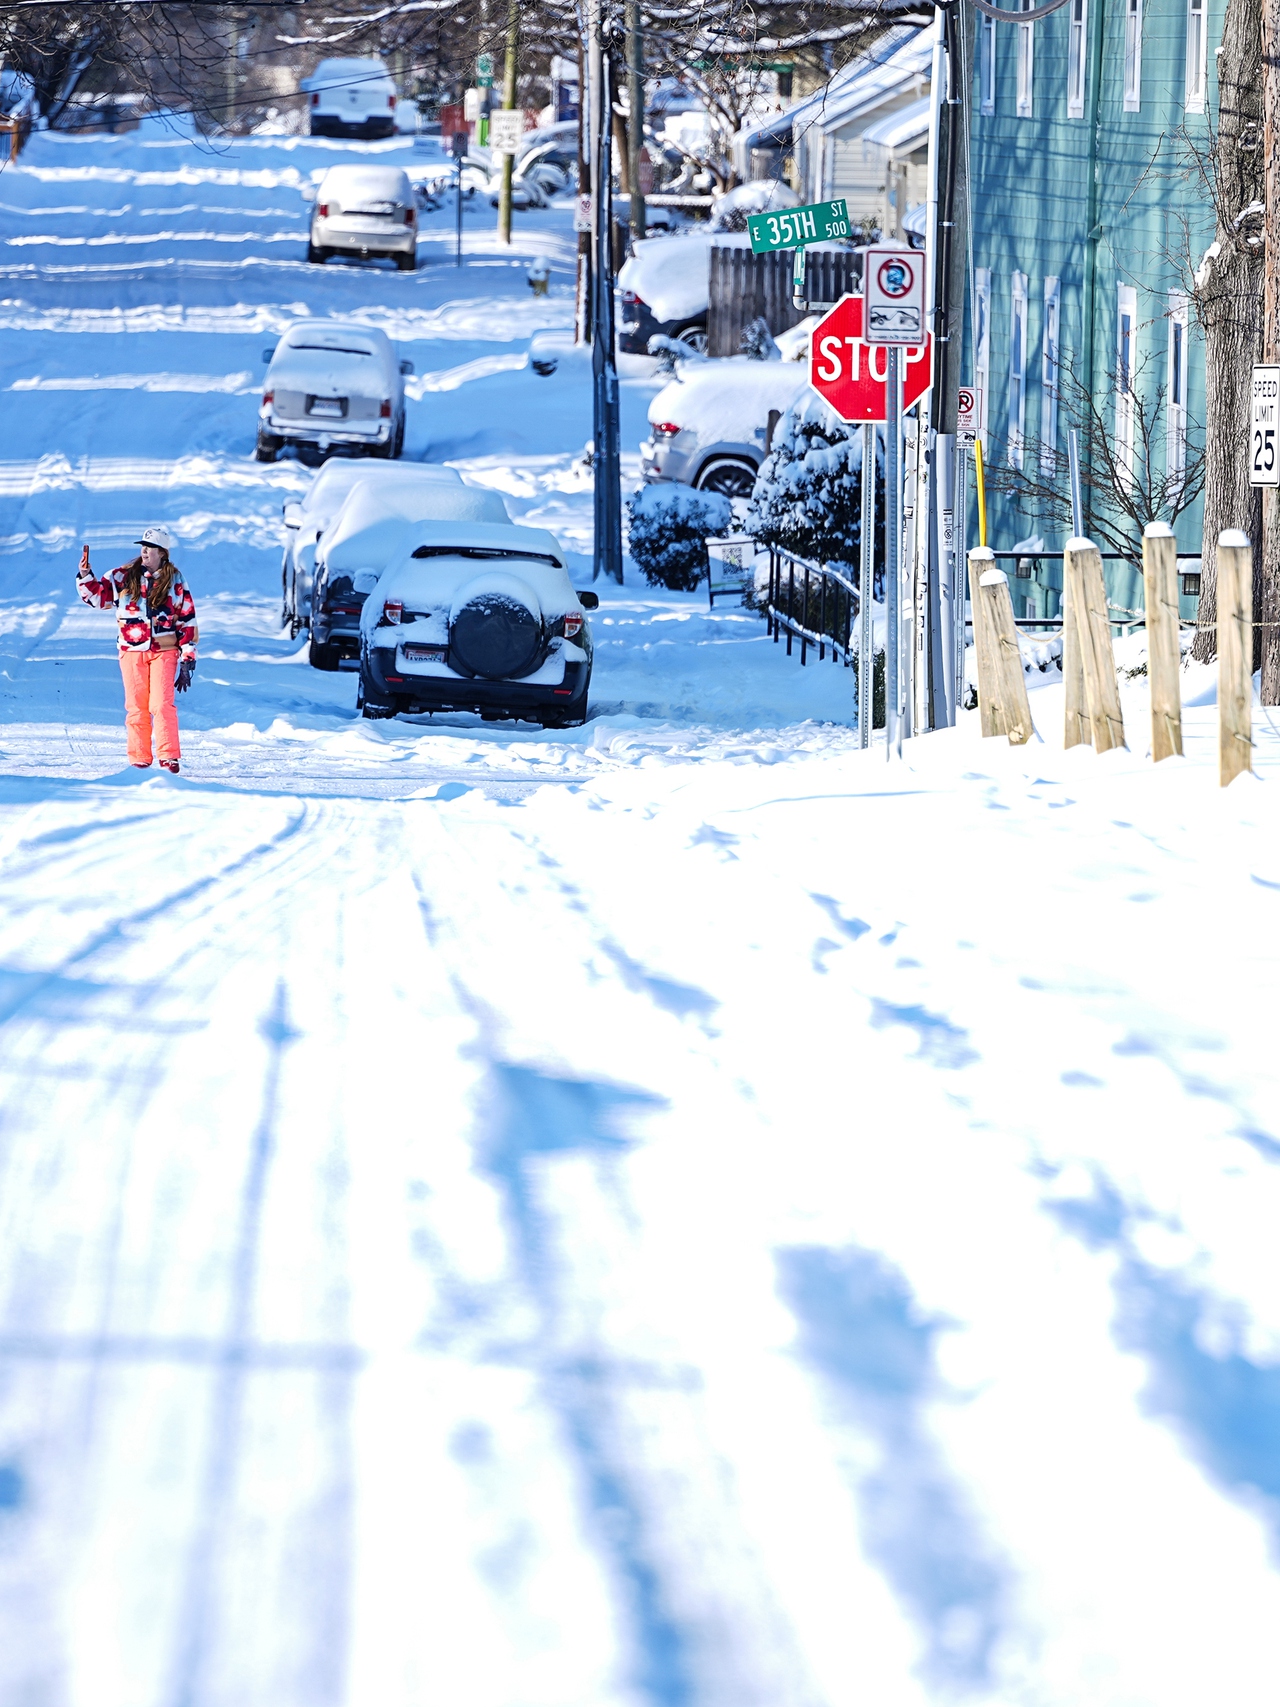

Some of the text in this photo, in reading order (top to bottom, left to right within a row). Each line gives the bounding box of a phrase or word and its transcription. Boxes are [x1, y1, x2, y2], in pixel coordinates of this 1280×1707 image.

[494, 133, 518, 149] 25
[753, 202, 842, 245] E 35TH ST
[825, 220, 847, 238] 500
[817, 336, 925, 382] STOP
[1254, 381, 1278, 397] SPEED
[1255, 405, 1274, 422] LIMIT
[1254, 430, 1275, 471] 25
